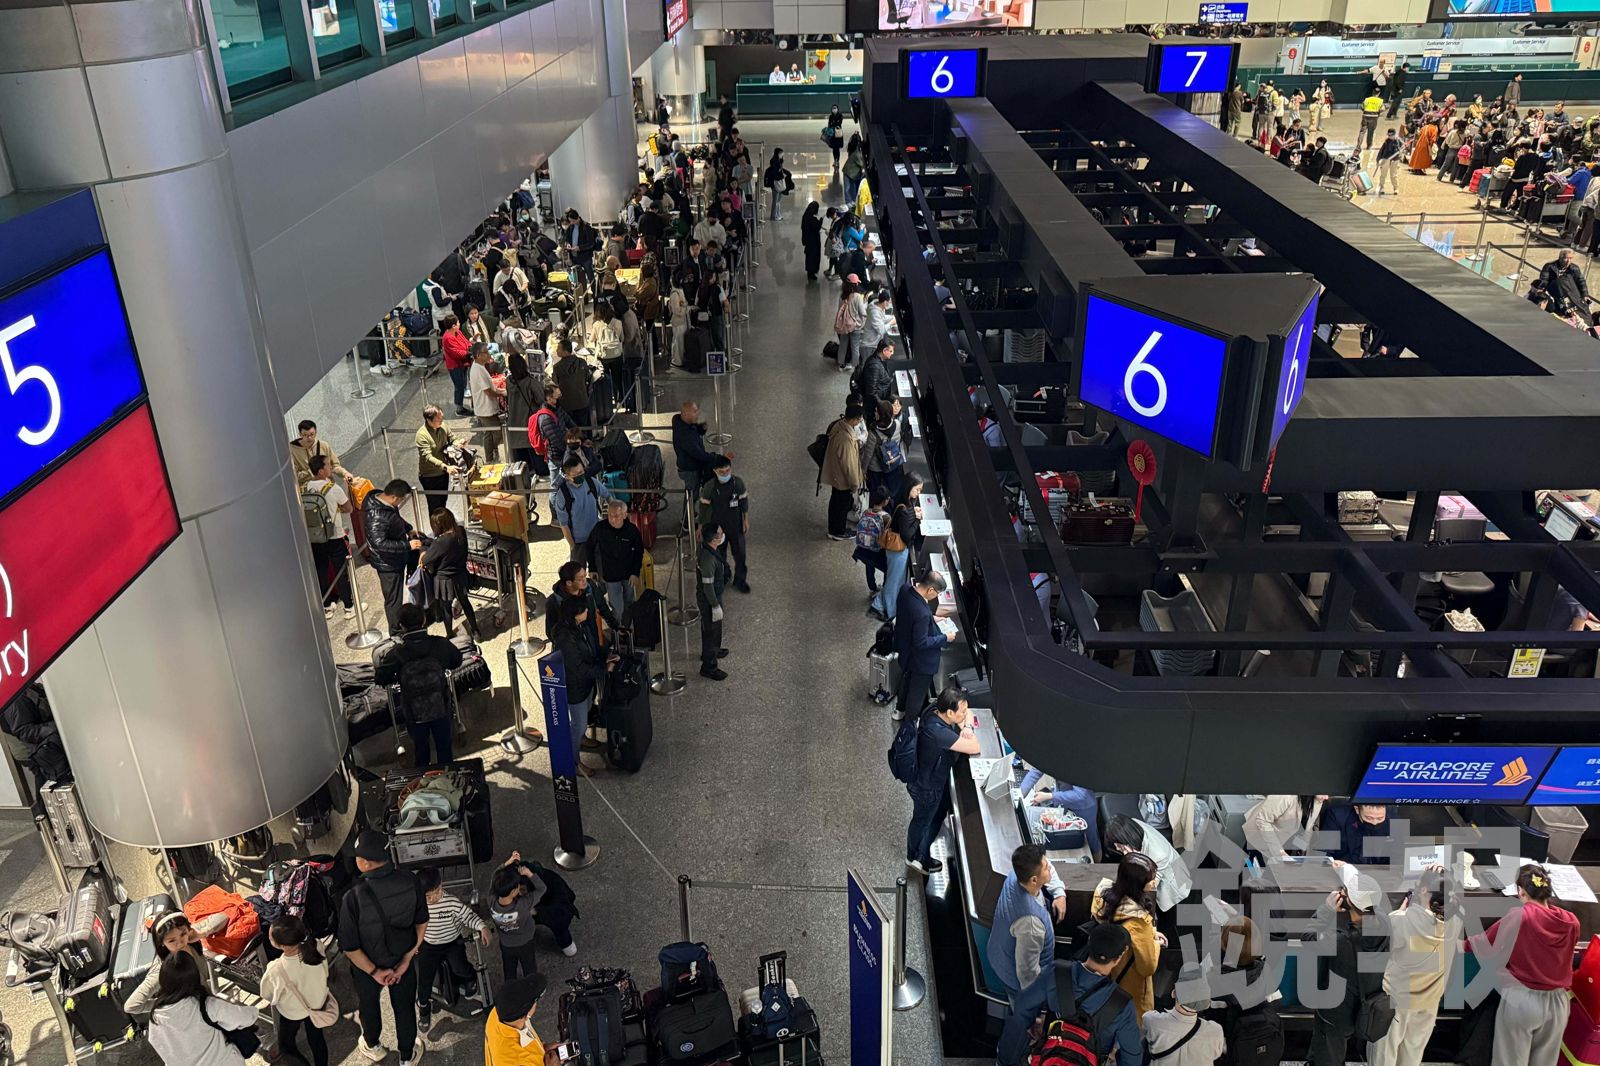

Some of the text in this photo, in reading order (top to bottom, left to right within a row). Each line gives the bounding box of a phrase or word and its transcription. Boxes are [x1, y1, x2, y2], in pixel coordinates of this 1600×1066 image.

[930, 55, 954, 94] 6
[1184, 50, 1208, 88] 7
[0, 314, 61, 446] 5
[1123, 330, 1168, 417] 6
[1283, 323, 1305, 415] 6
[0, 628, 29, 684] ry
[1374, 760, 1495, 771] SINGAPORE
[1393, 770, 1491, 780] AIRLINES
[556, 794, 576, 803] GOLD
